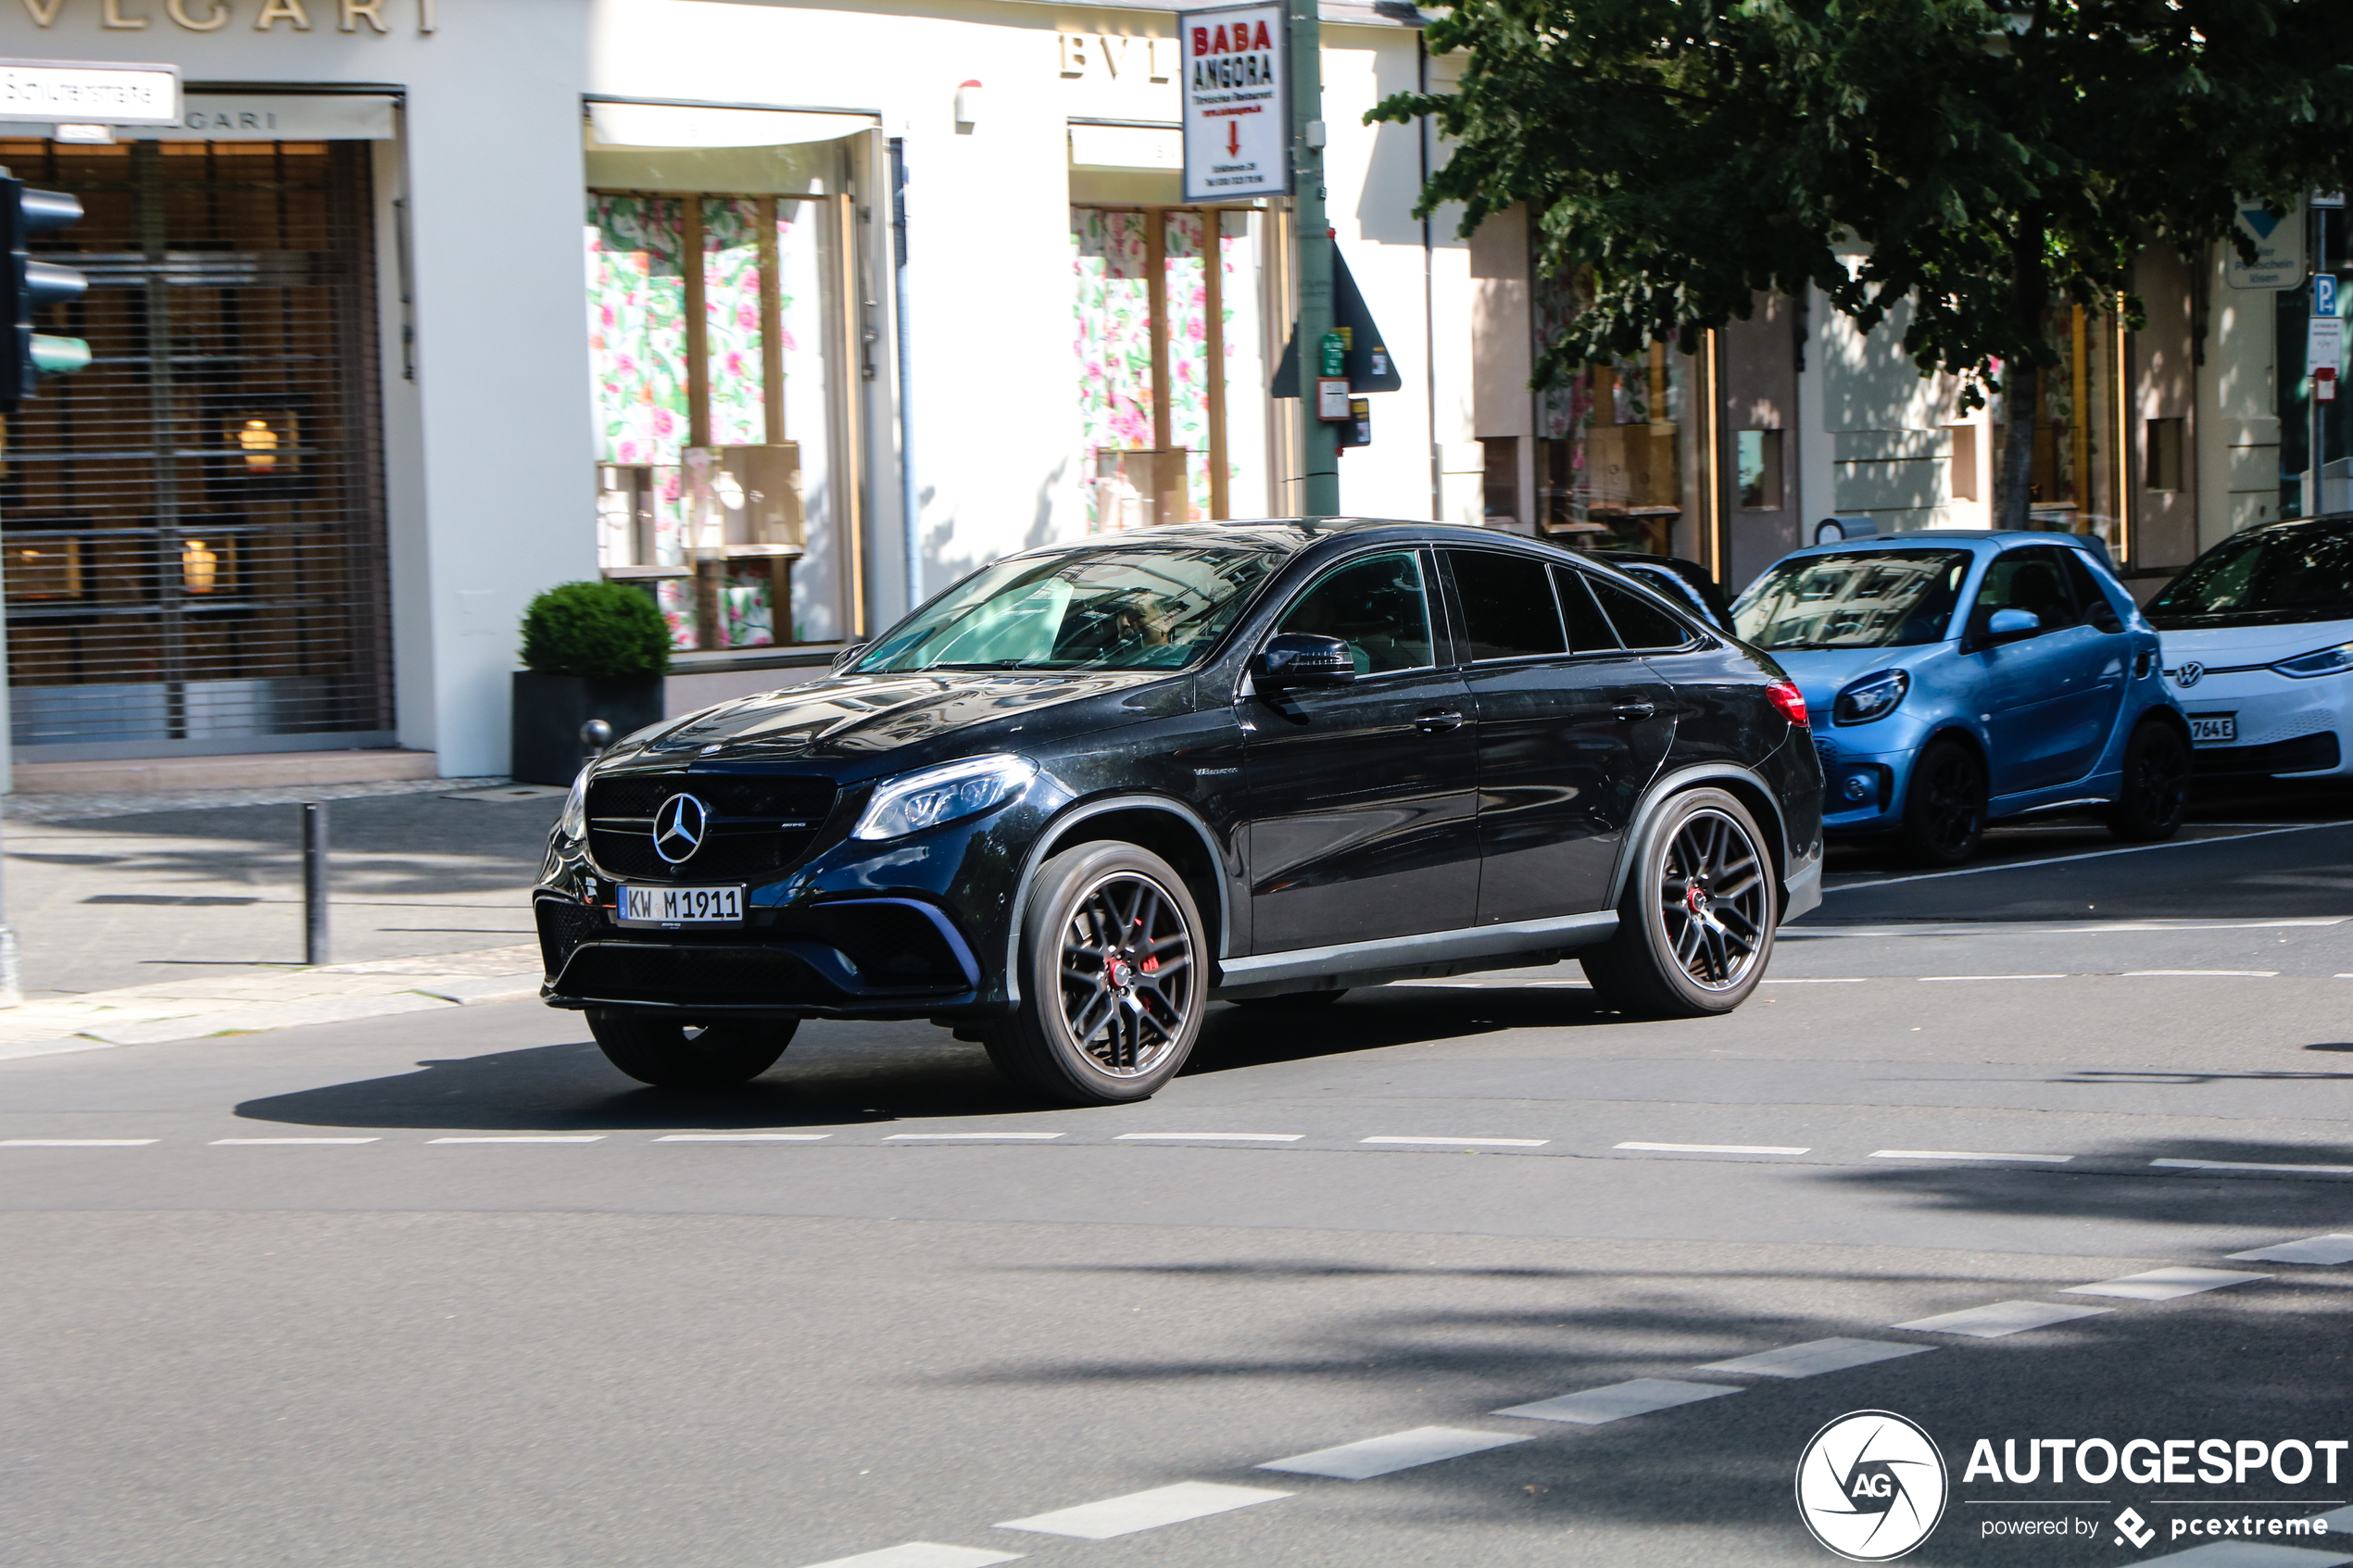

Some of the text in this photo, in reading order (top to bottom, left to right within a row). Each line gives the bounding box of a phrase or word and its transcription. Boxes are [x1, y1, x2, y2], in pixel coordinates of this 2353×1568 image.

[1191, 20, 1273, 56] BABA
[1059, 33, 1171, 84] BVL
[1192, 54, 1273, 92] ANGORA
[628, 890, 651, 918] KW
